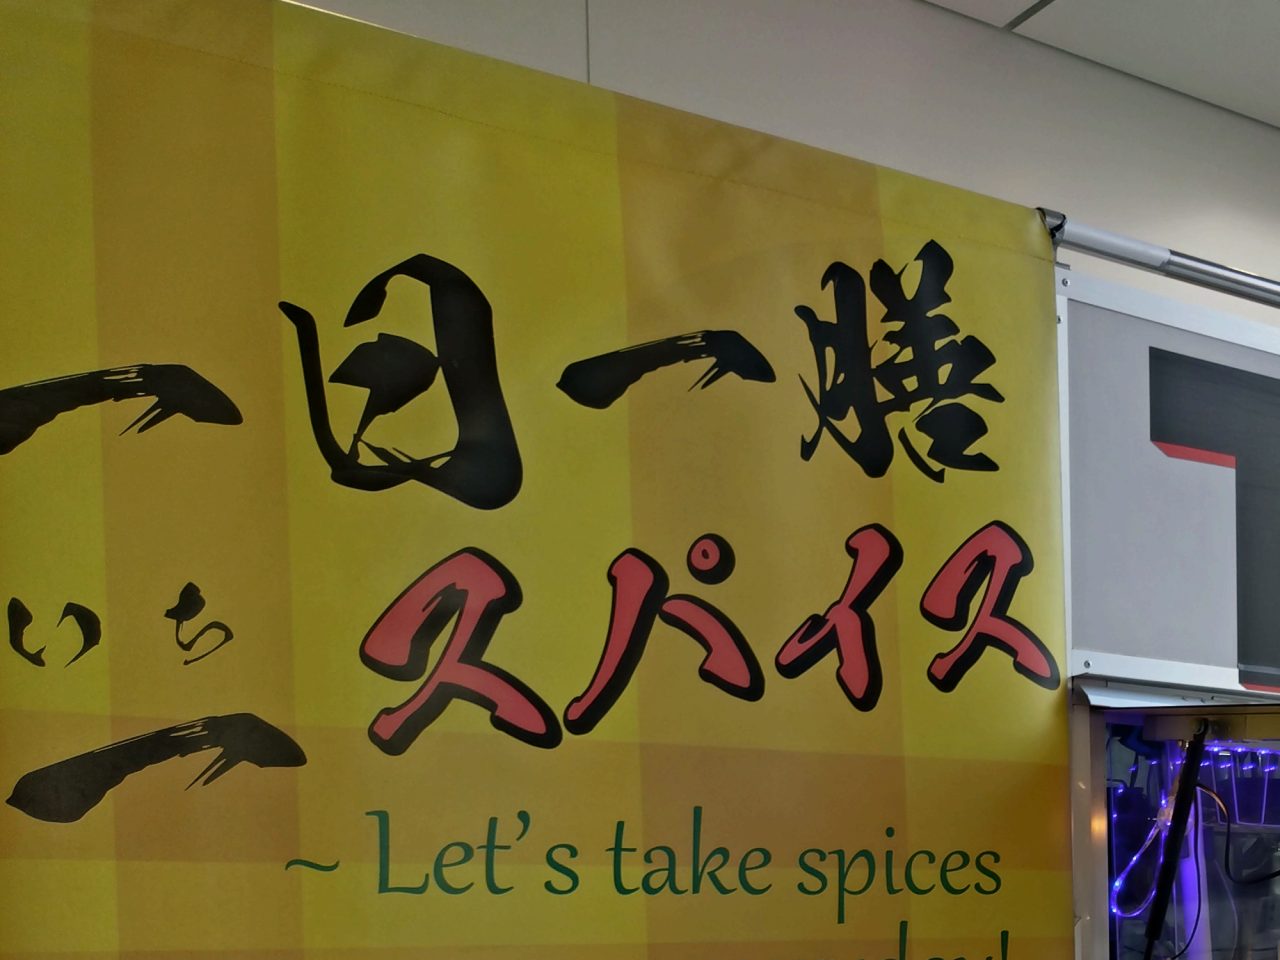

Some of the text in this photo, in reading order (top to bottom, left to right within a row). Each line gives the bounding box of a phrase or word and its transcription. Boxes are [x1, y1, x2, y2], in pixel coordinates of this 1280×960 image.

[358, 519, 1060, 756] スパイス
[367, 810, 580, 897] Let's
[606, 806, 772, 898] take
[797, 827, 1002, 924] spices
